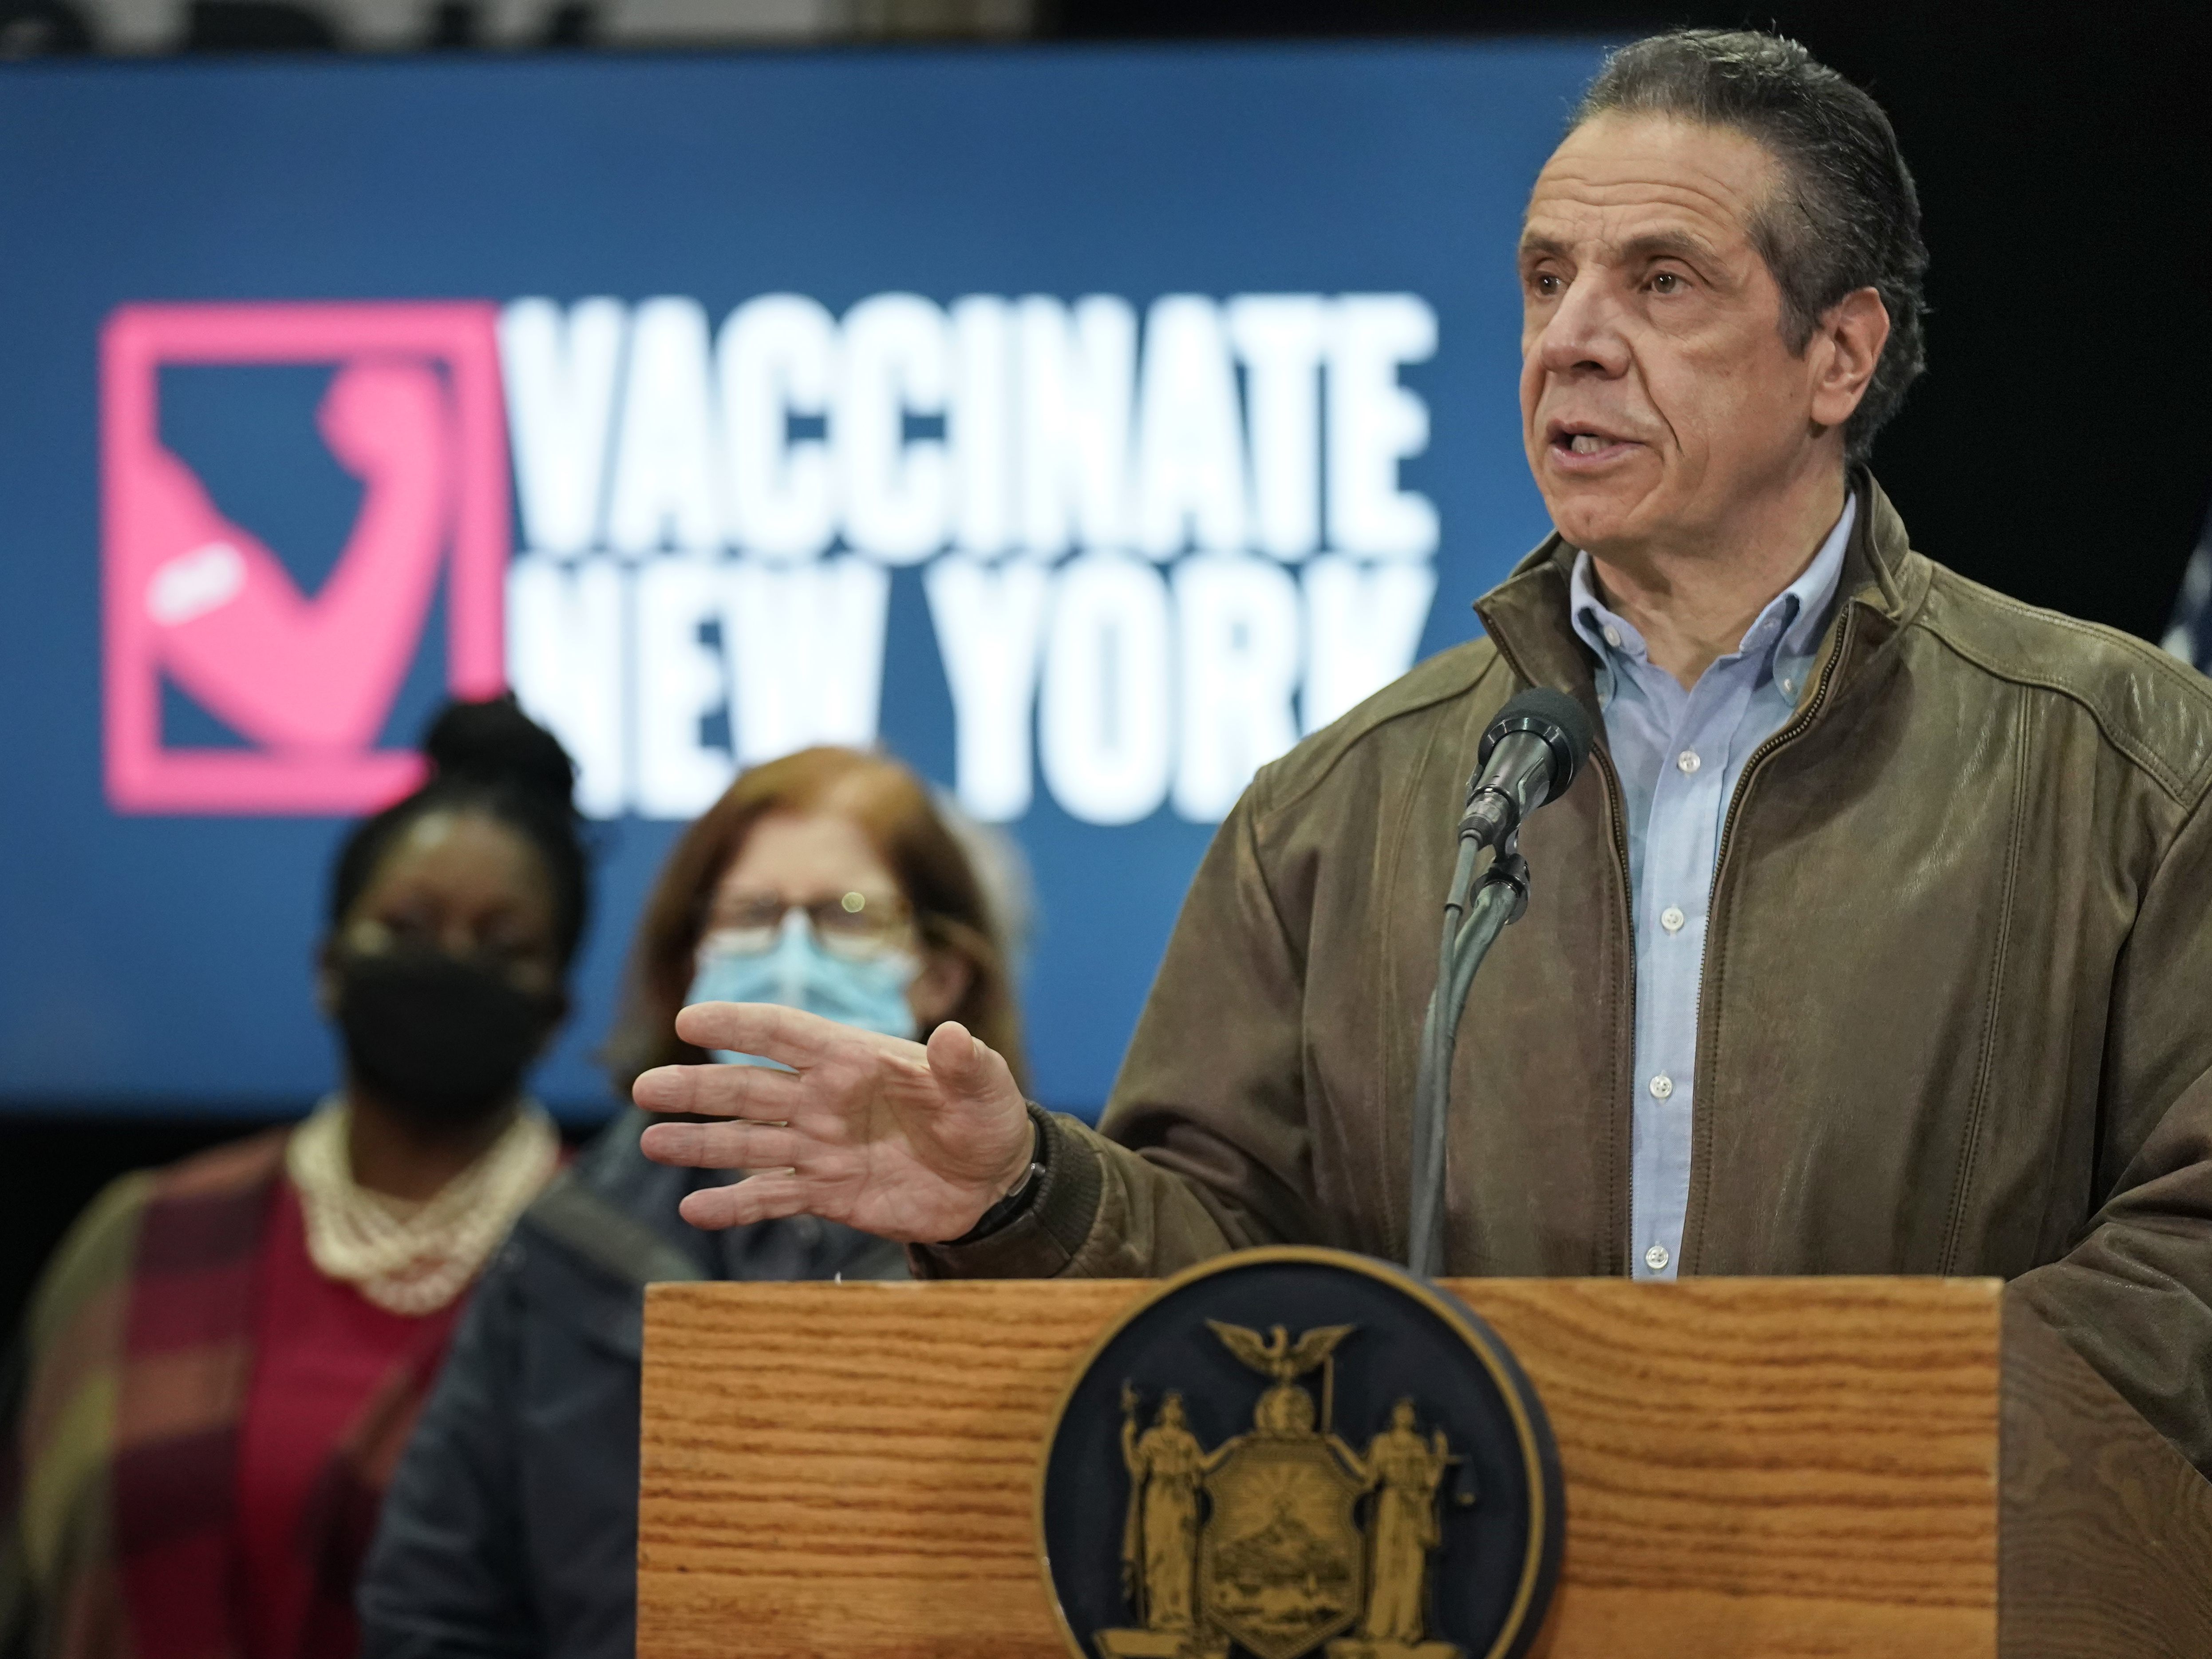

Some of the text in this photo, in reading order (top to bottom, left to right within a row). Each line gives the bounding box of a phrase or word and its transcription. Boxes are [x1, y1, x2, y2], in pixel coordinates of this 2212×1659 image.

[499, 293, 1439, 564] VACCINATE
[508, 553, 1438, 825] NEW YORK
